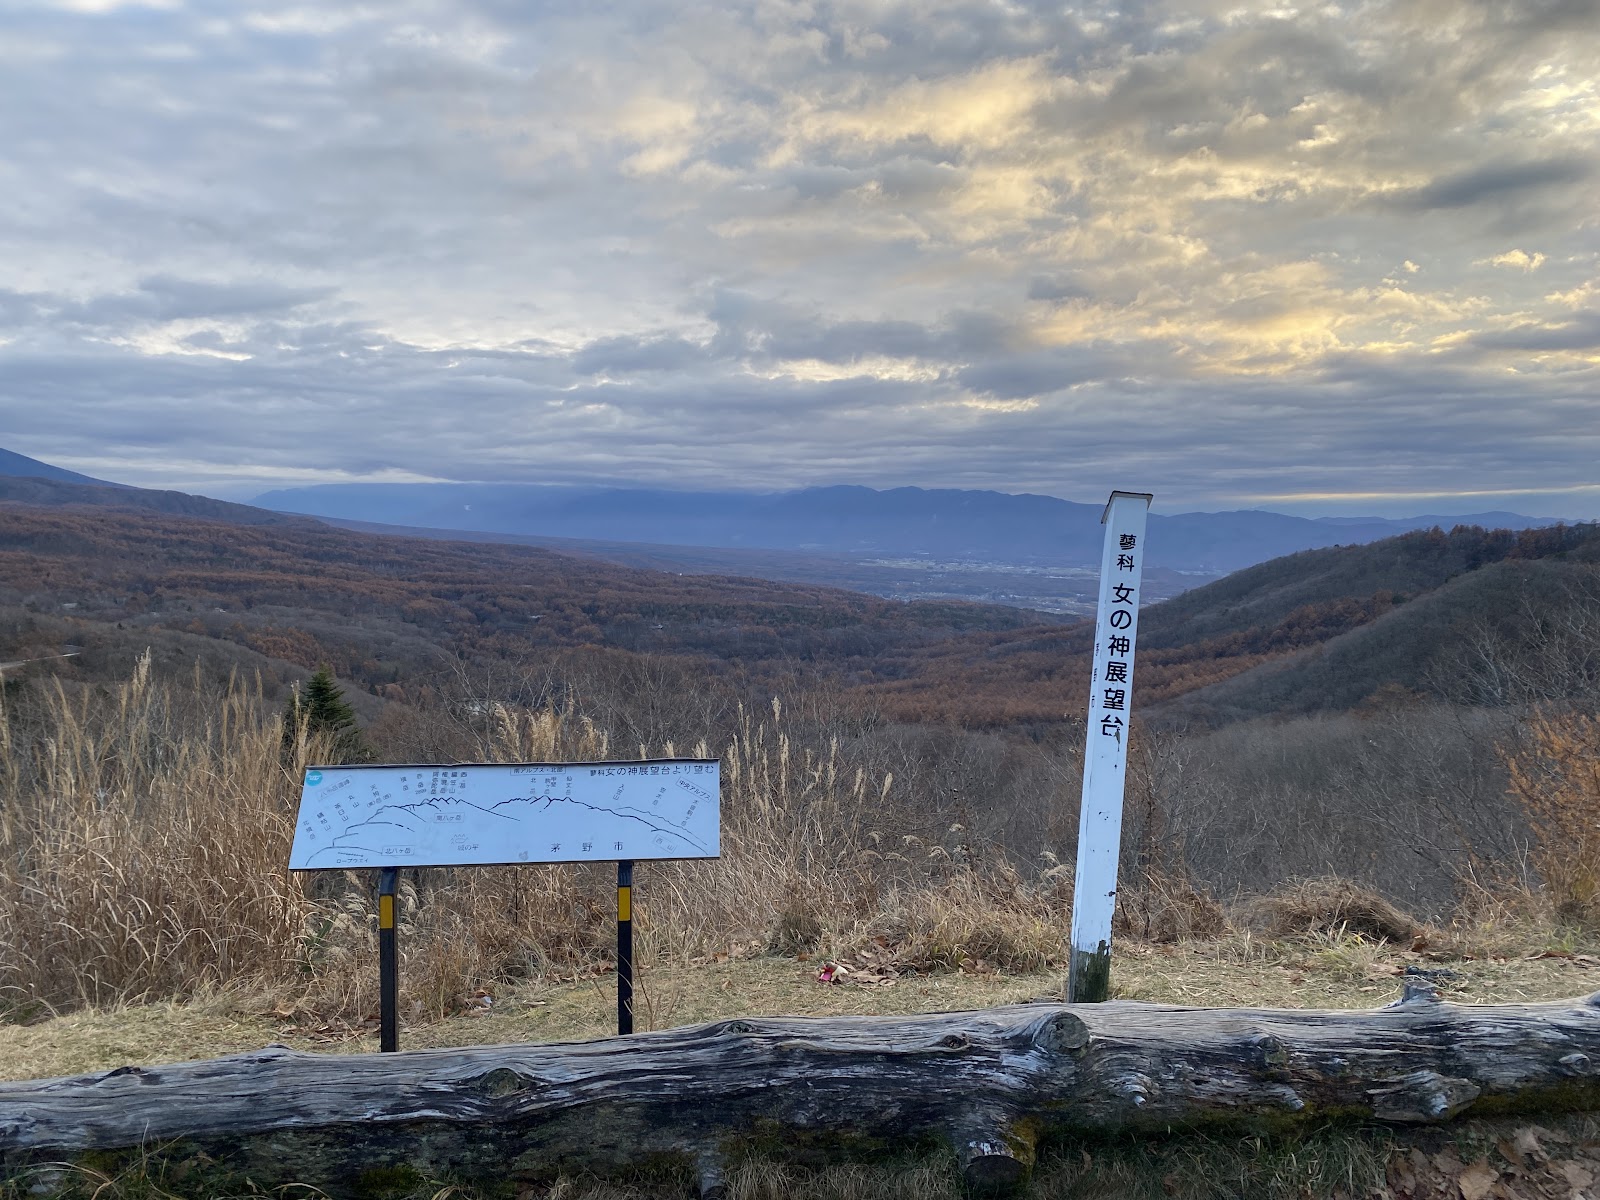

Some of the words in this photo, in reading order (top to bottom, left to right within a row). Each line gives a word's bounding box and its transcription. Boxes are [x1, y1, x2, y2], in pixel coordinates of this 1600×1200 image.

[1100, 533, 1137, 737] 蓼科女の神展望台
[590, 765, 714, 777] 蓼科女の神展望台より望む
[679, 780, 712, 800] 中央アルプス
[550, 841, 624, 853] 茅野市
